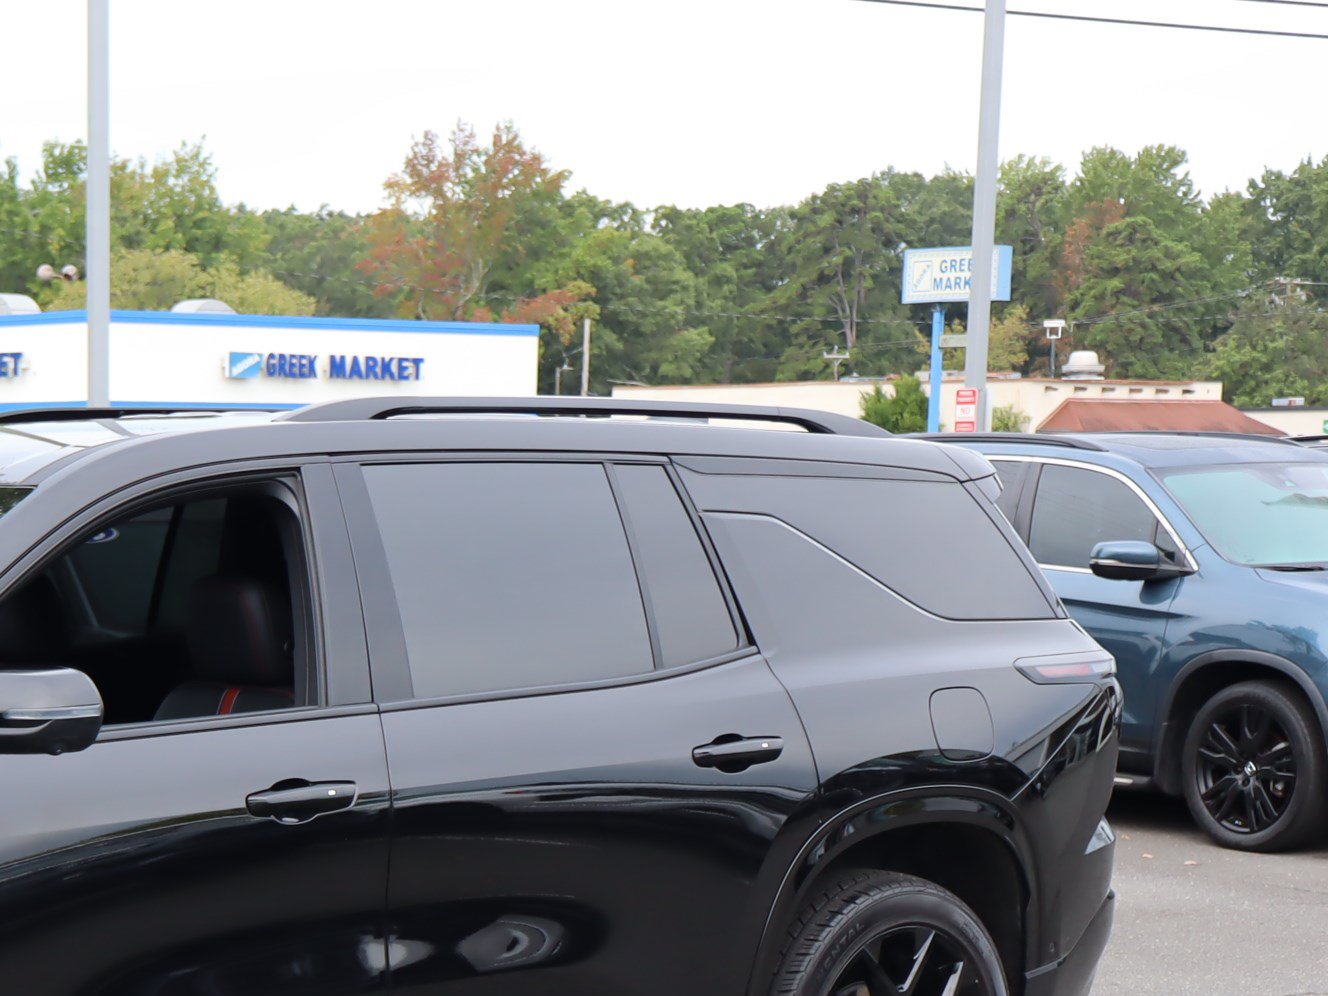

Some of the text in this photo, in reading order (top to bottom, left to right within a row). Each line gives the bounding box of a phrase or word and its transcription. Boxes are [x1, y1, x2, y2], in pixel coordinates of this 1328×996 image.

[939, 258, 972, 274] GREE
[933, 277, 972, 291] MARK
[266, 352, 317, 378] GREEK
[329, 355, 425, 381] MARKET
